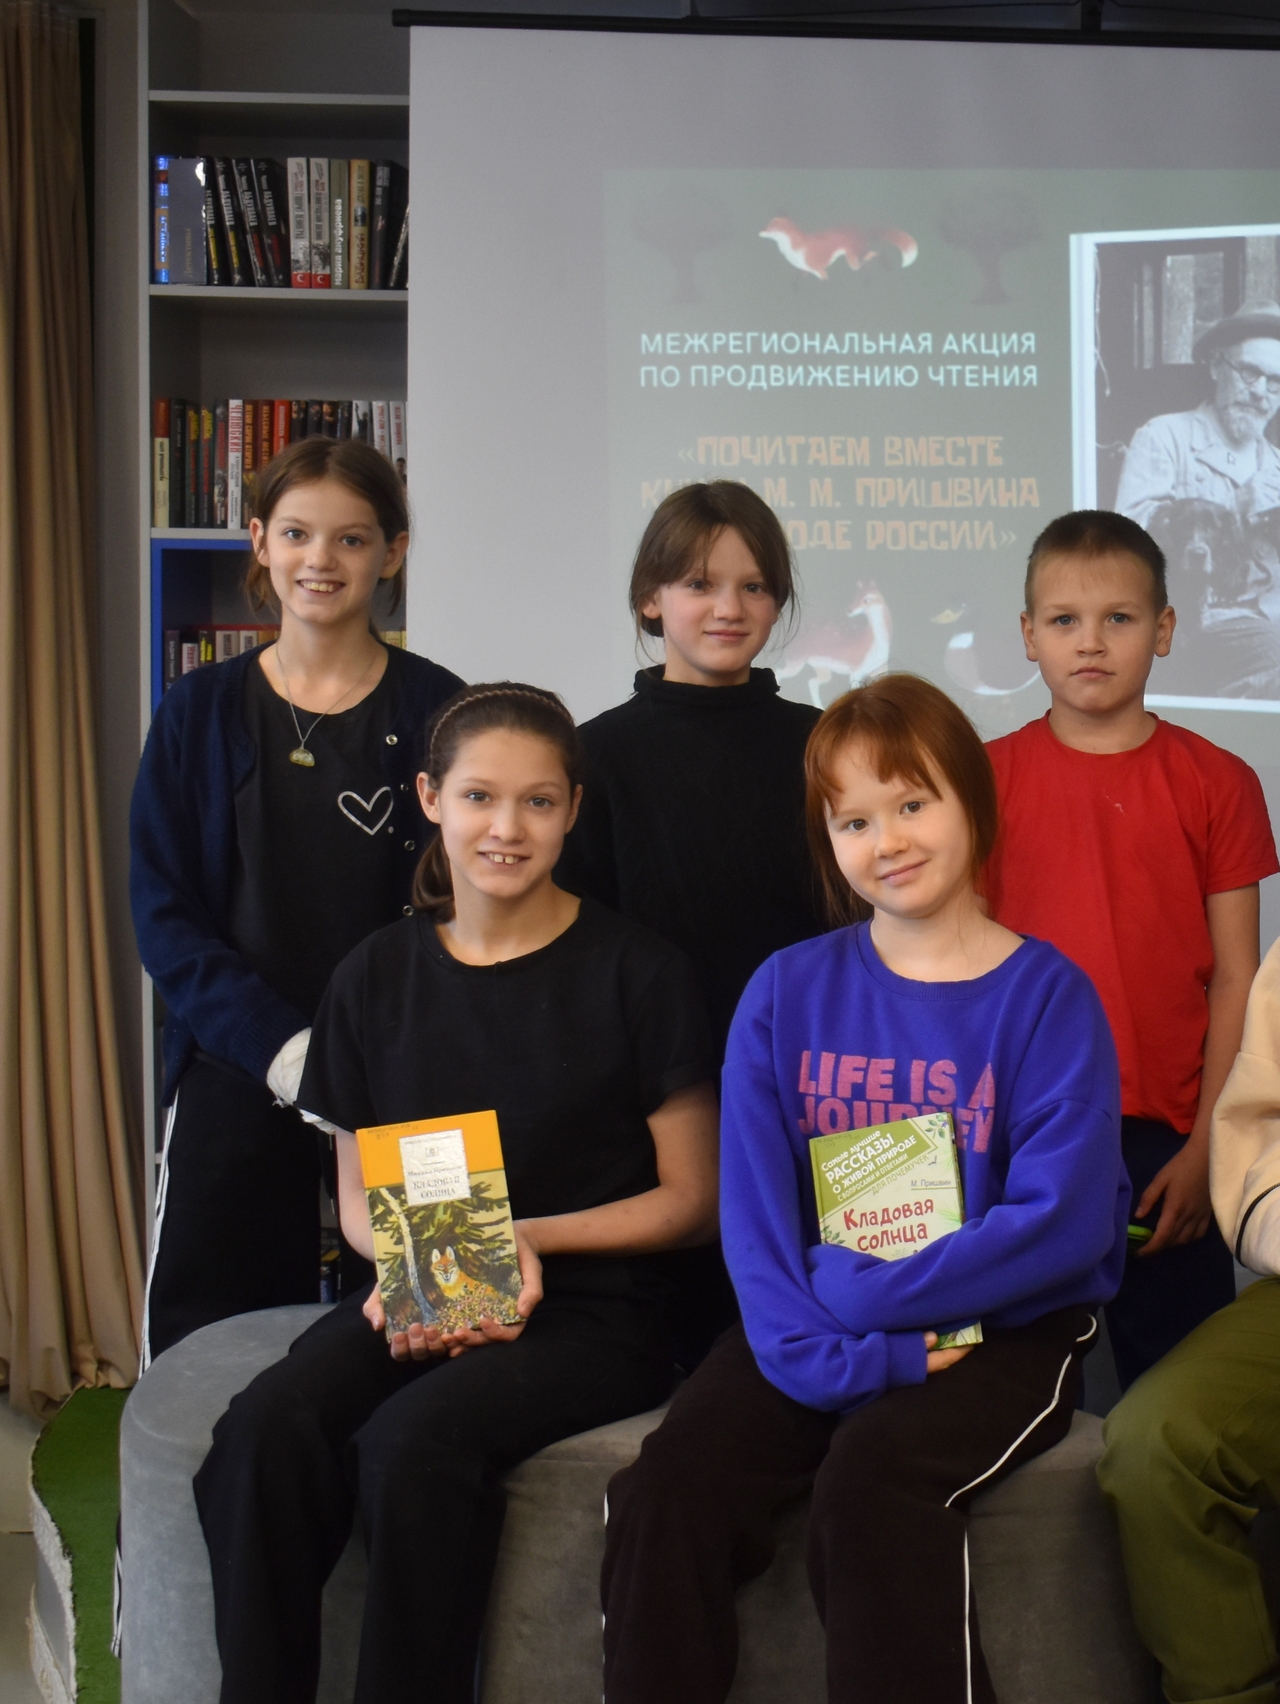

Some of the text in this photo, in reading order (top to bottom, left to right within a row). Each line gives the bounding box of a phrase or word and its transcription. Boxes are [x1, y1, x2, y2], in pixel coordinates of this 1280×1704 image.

[640, 331, 1037, 358] МЕЖРЕГИОНАЛЬНАЯ АКЦИЯ
[639, 363, 1038, 391] ПО ПРОДВИЖЕНИЮ ЧТЕНИЯ
[229, 405, 242, 453] ЧЕЛЮСКИН
[678, 435, 1004, 467] «ПОЧИТАЕМ ВМЕСТЕ
[763, 476, 796, 508] М.
[809, 476, 842, 508] М.
[855, 476, 1041, 508] ПРИШВИНА
[866, 520, 1018, 551] РОССИИ»
[798, 1050, 997, 1110] LIFE IS A
[798, 1095, 995, 1154] JOUEY
[822, 1151, 849, 1171] Самые
[850, 1130, 881, 1154] лучшие
[825, 1133, 895, 1184] РАССКАЗЫ
[832, 1184, 842, 1194] О
[842, 1161, 876, 1188] ЖИВОЙ
[876, 1135, 917, 1166] ПРИРОДЕ
[413, 1176, 460, 1190] КЛАДОВАЯ
[842, 1174, 876, 1199] ВОПРОСАМИ
[880, 1153, 909, 1175] ОТВЕТАМИ
[871, 1153, 930, 1195] ДЛЯ ПОЧЕМУЧЕК
[910, 1178, 952, 1187] М. Пришвин
[420, 1187, 456, 1199] СОЛНЦА
[843, 1198, 934, 1231] Кладовая
[857, 1222, 928, 1252] солнца
